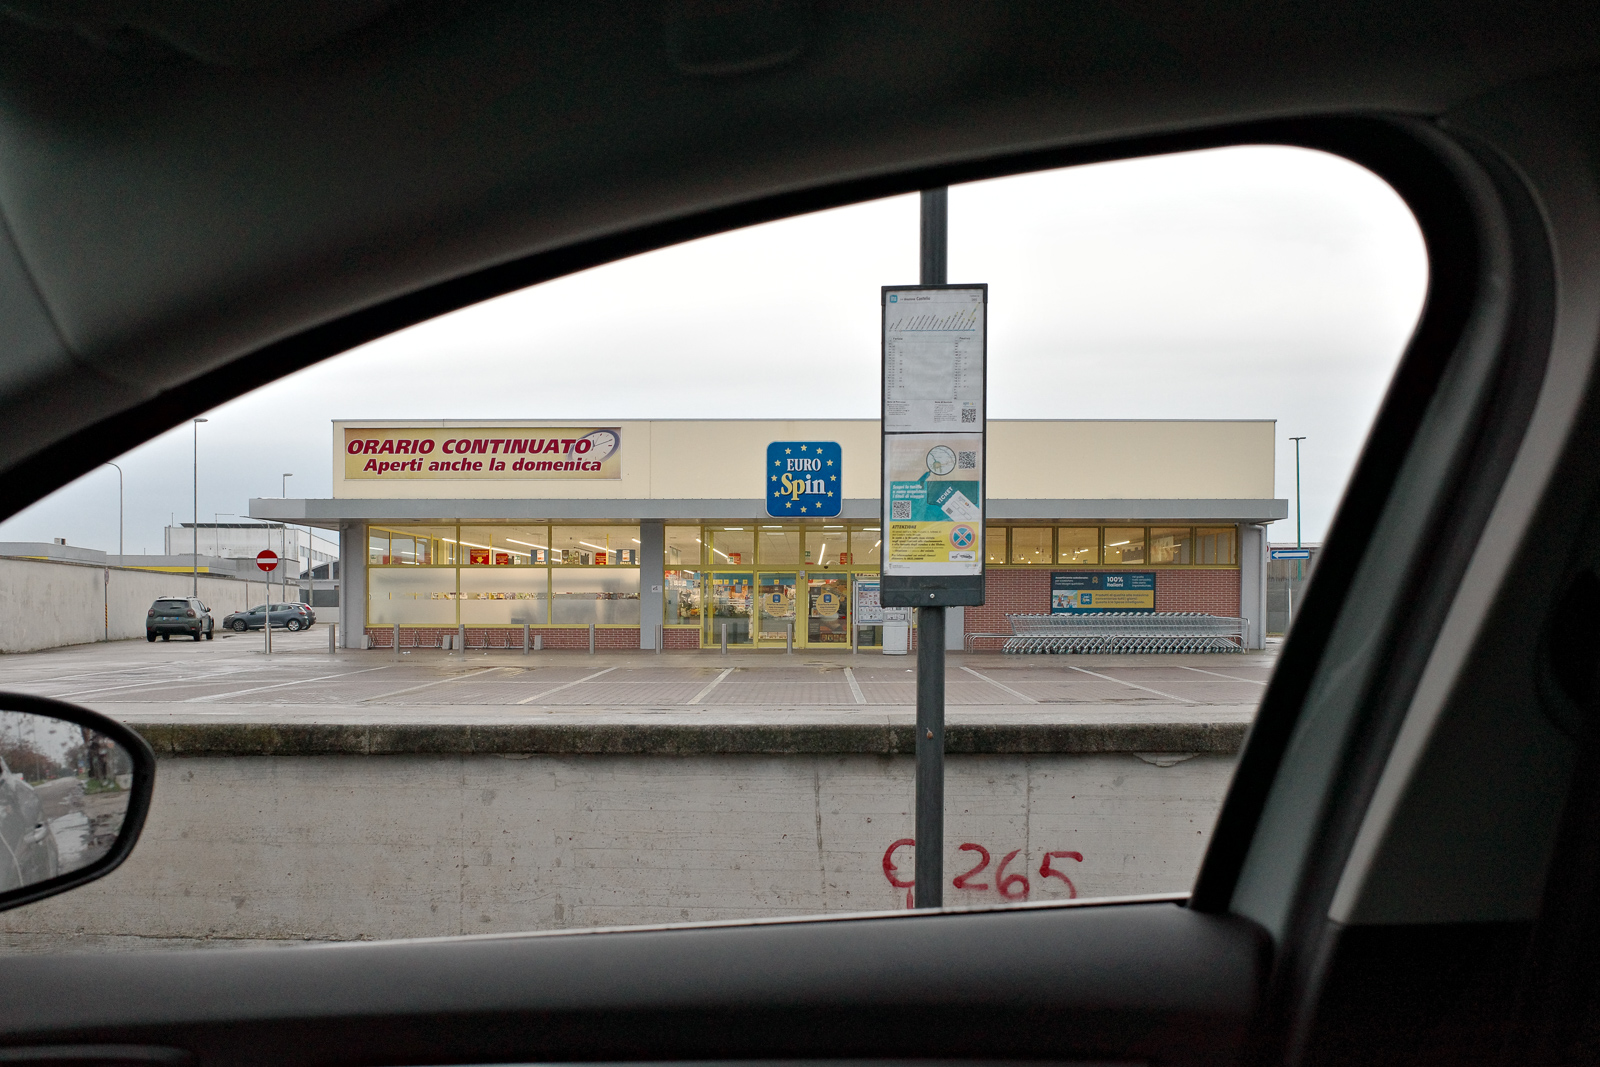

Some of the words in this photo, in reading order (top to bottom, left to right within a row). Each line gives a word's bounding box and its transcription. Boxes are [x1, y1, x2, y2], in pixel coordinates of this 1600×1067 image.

[347, 438, 435, 454] ORARIO
[442, 438, 592, 454] CONTINUATO
[363, 457, 422, 474] Aperti
[428, 458, 482, 472] anche
[488, 458, 504, 472] la
[511, 457, 602, 472] domenica
[787, 458, 822, 472] EURO
[780, 472, 826, 501] Spin
[936, 486, 953, 504] TICKET
